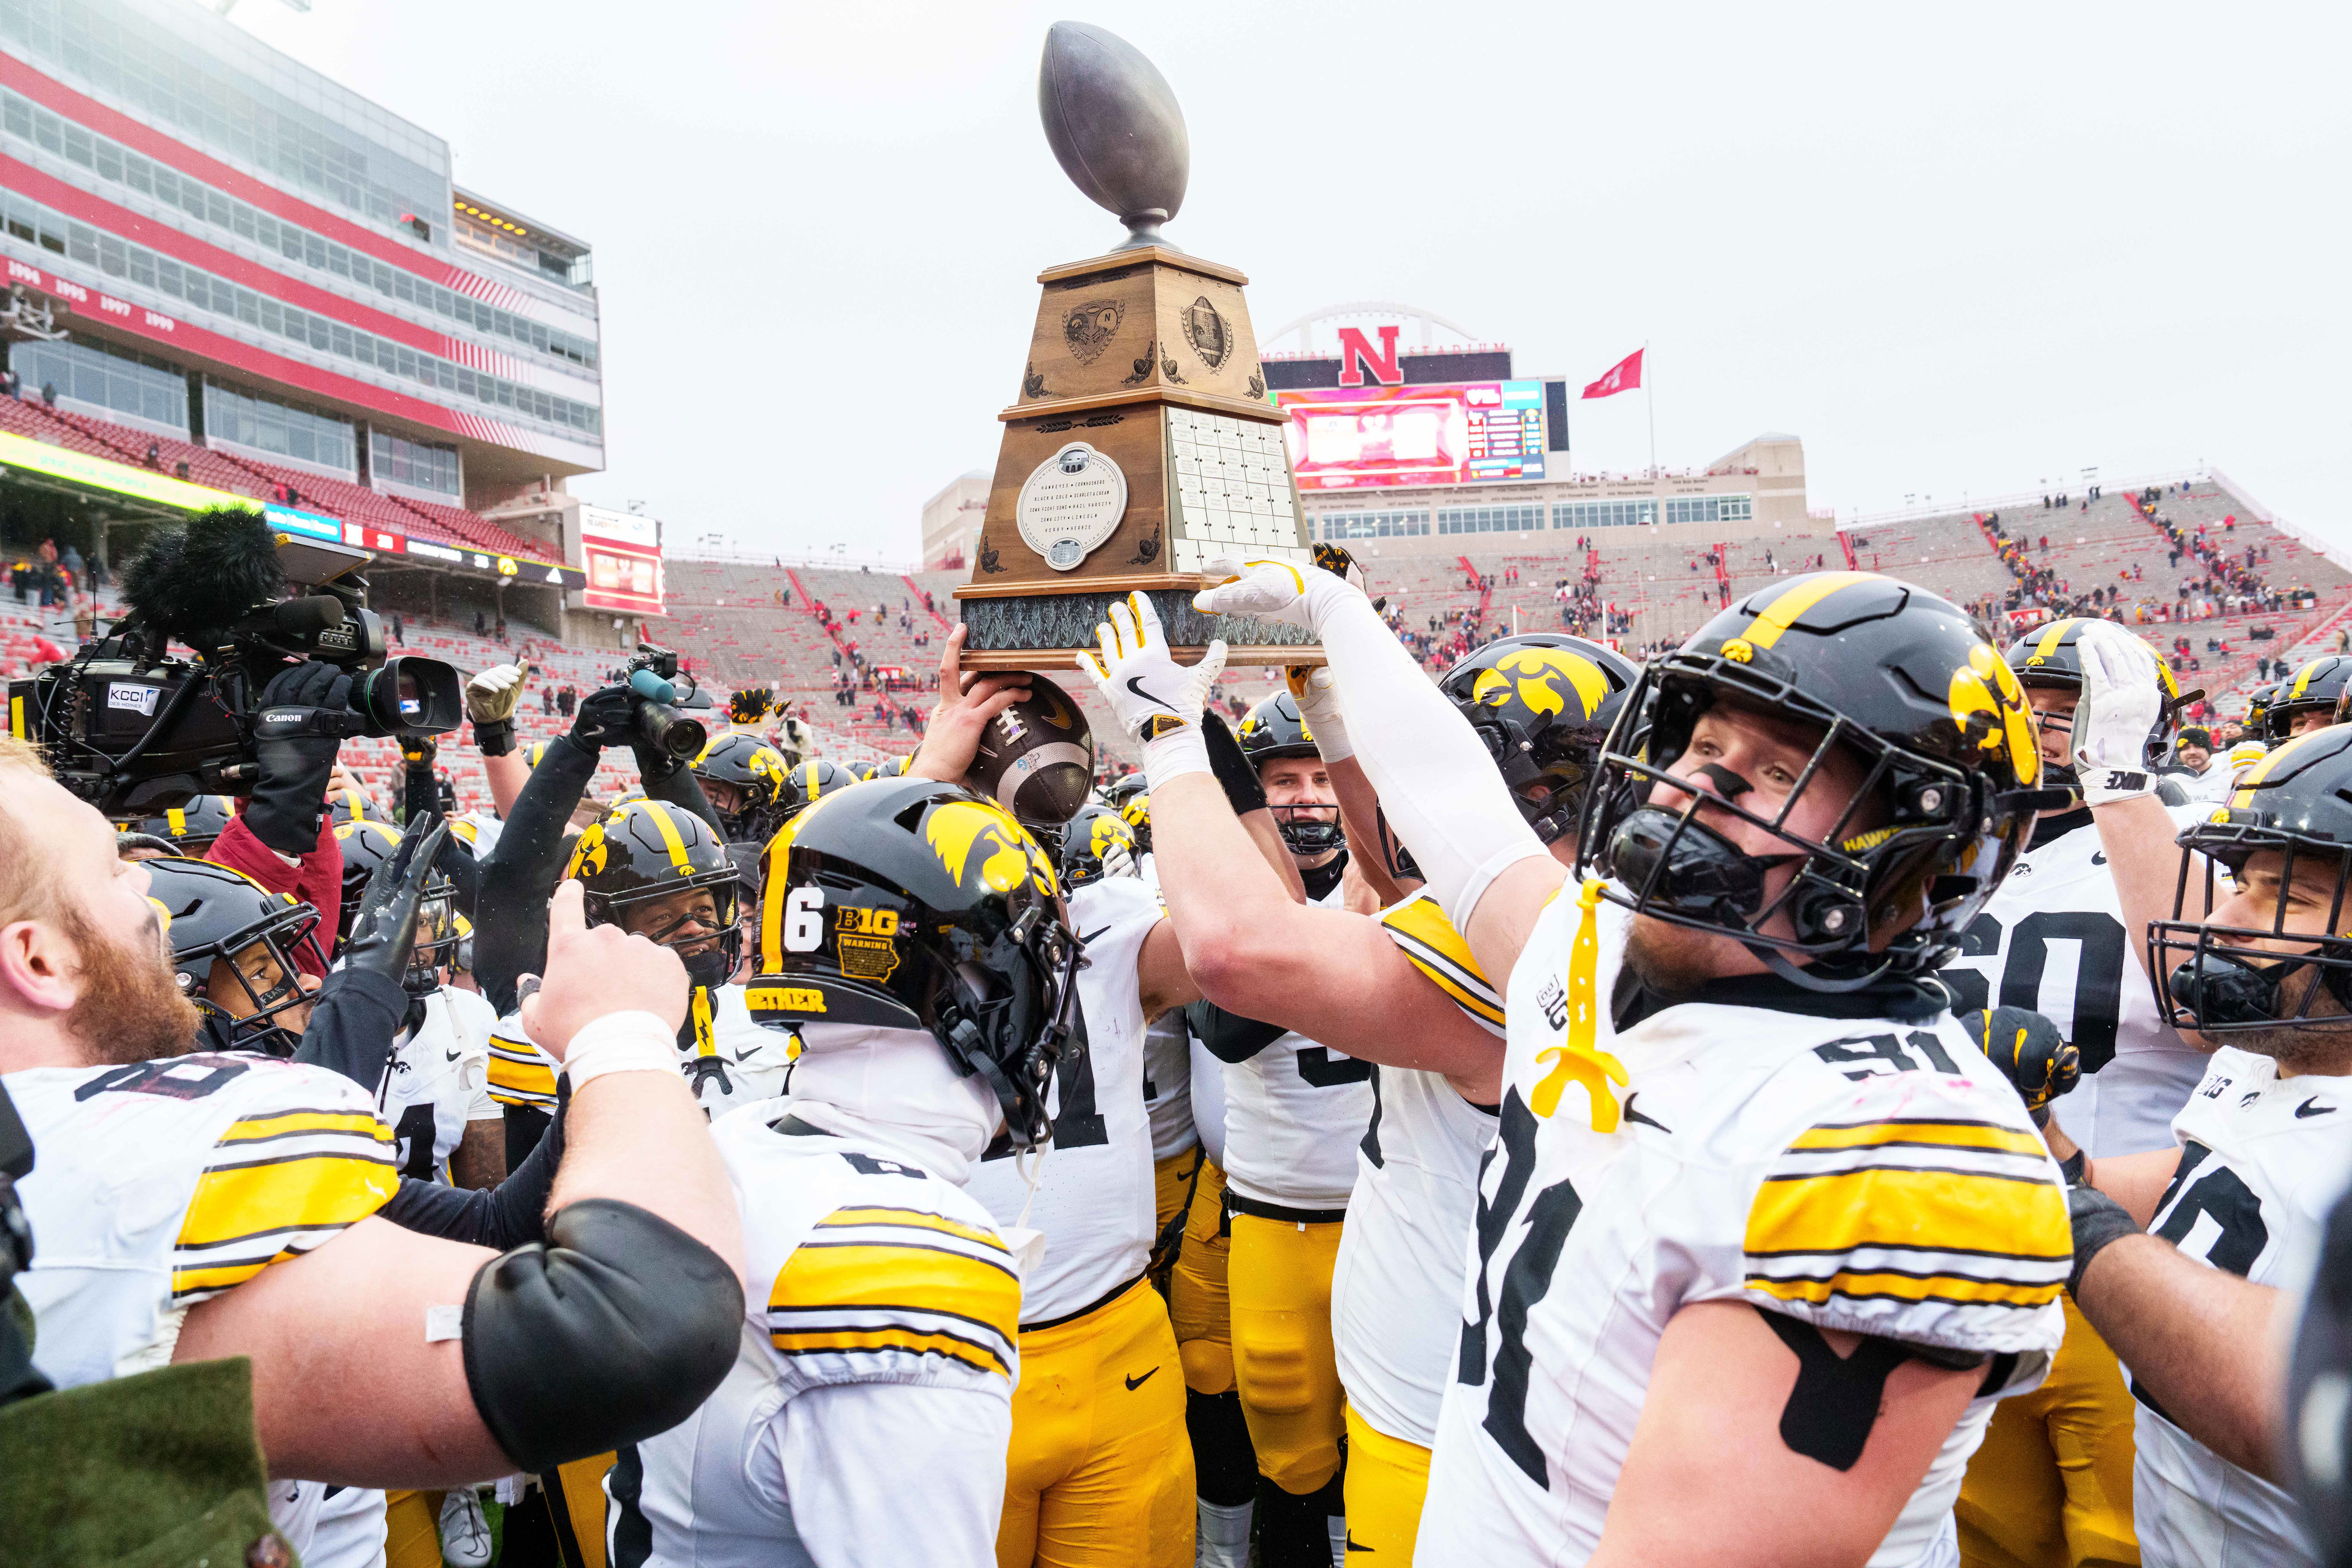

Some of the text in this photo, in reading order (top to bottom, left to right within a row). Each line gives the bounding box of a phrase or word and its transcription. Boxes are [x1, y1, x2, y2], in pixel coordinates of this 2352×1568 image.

[1158, 266, 1240, 294] VALOR
[1338, 325, 1404, 386] N
[1409, 342, 1506, 356] STADIUM
[1092, 462, 1114, 483] STADIUM
[111, 689, 143, 702] KCCI
[198, 688, 223, 697] SOY
[266, 714, 302, 722] Canon
[784, 887, 825, 952] 6
[843, 938, 888, 950] WARNING
[1812, 1030, 1962, 1081] 91
